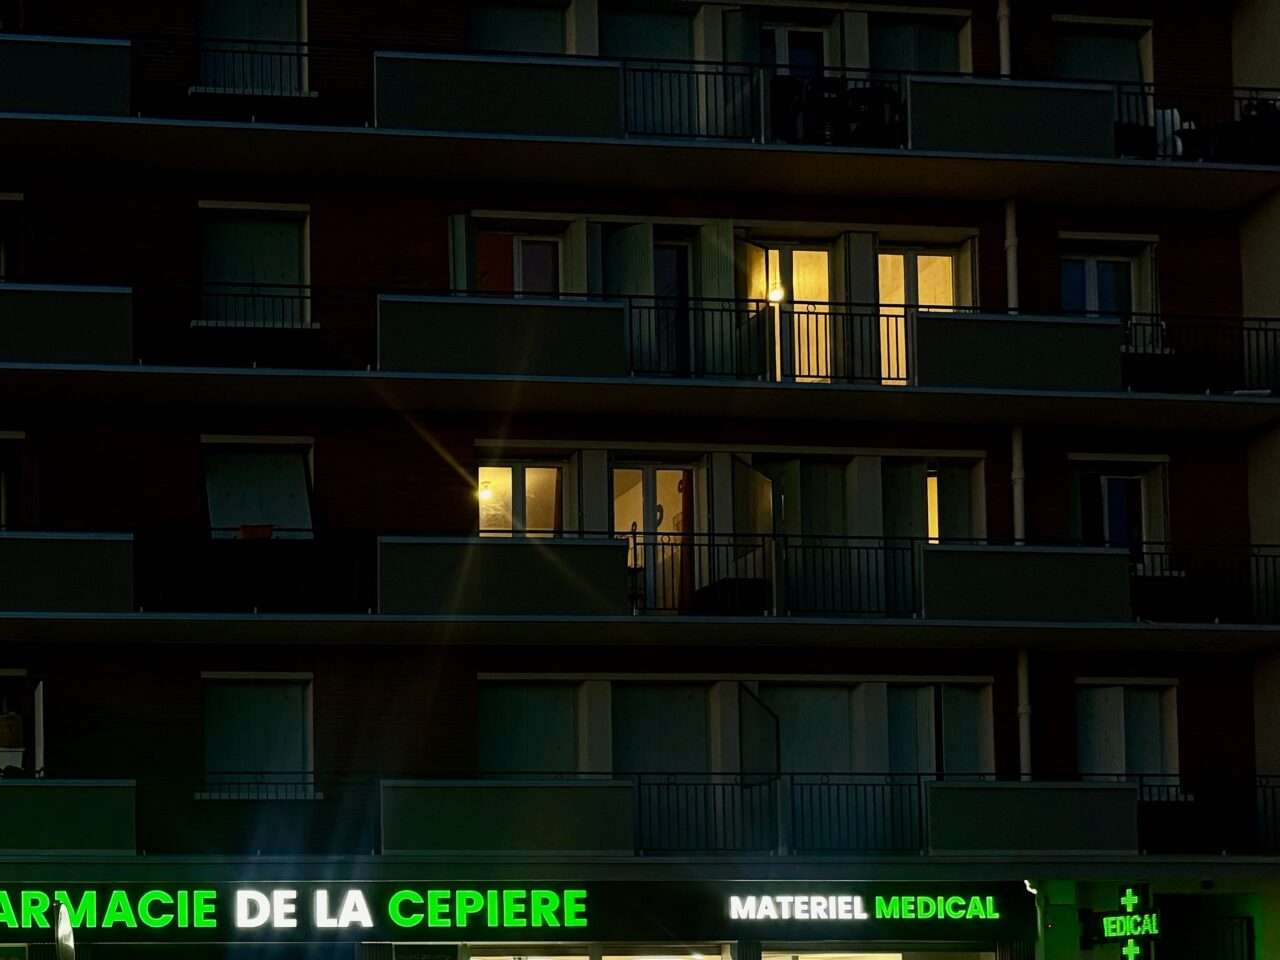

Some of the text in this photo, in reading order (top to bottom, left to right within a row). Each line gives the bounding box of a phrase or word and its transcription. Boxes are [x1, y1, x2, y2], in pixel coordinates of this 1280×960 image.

[234, 889, 299, 929] DE
[314, 889, 375, 928] LA
[388, 890, 588, 928] CEPIERE
[728, 896, 1000, 921] MATERIEL MEDICAL
[1103, 914, 1159, 937] EDICAL
